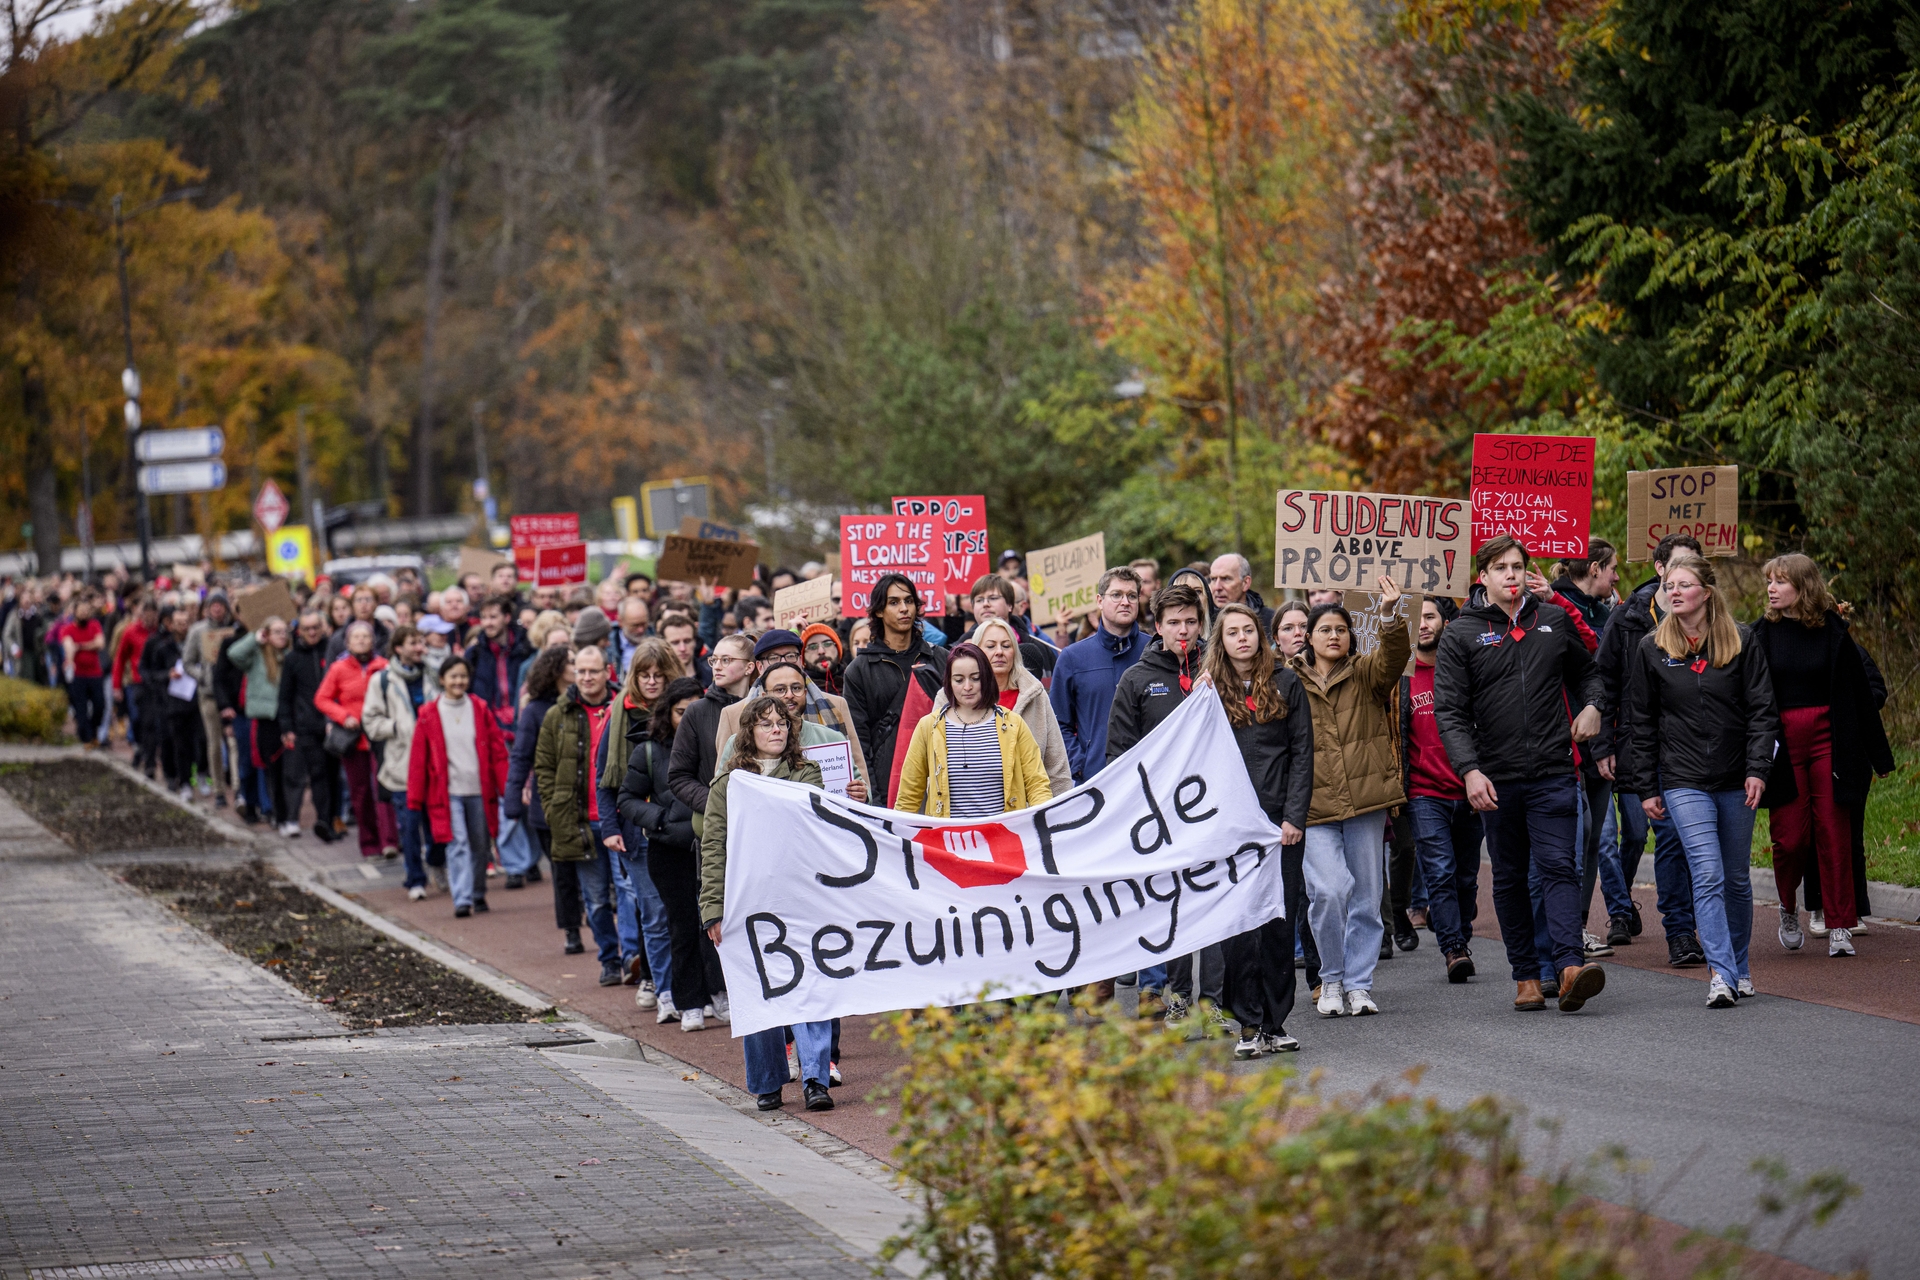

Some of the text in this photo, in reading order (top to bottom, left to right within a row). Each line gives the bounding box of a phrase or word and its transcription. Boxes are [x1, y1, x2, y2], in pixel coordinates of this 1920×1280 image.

[1489, 439, 1586, 462] STOP DE
[1472, 465, 1588, 487] BEZUINIGINGEN
[1651, 471, 1716, 499] STOP
[1472, 487, 1553, 512] (IF YOU CAN
[1669, 502, 1706, 519] MET
[1282, 491, 1462, 541] STUDENTS
[1480, 508, 1527, 521] READ
[847, 521, 933, 541] STOP THE
[1471, 521, 1557, 537] THANK A
[943, 529, 988, 555] YPSE
[1332, 537, 1403, 558] ABOVE
[850, 541, 931, 566] LOONIES
[1043, 541, 1100, 577] EDUCATION
[907, 570, 936, 584] WITH
[851, 592, 872, 610] OU
[821, 764, 845, 772] derland.
[1130, 761, 1219, 855] de
[745, 842, 1267, 999] Bezuinigingen
